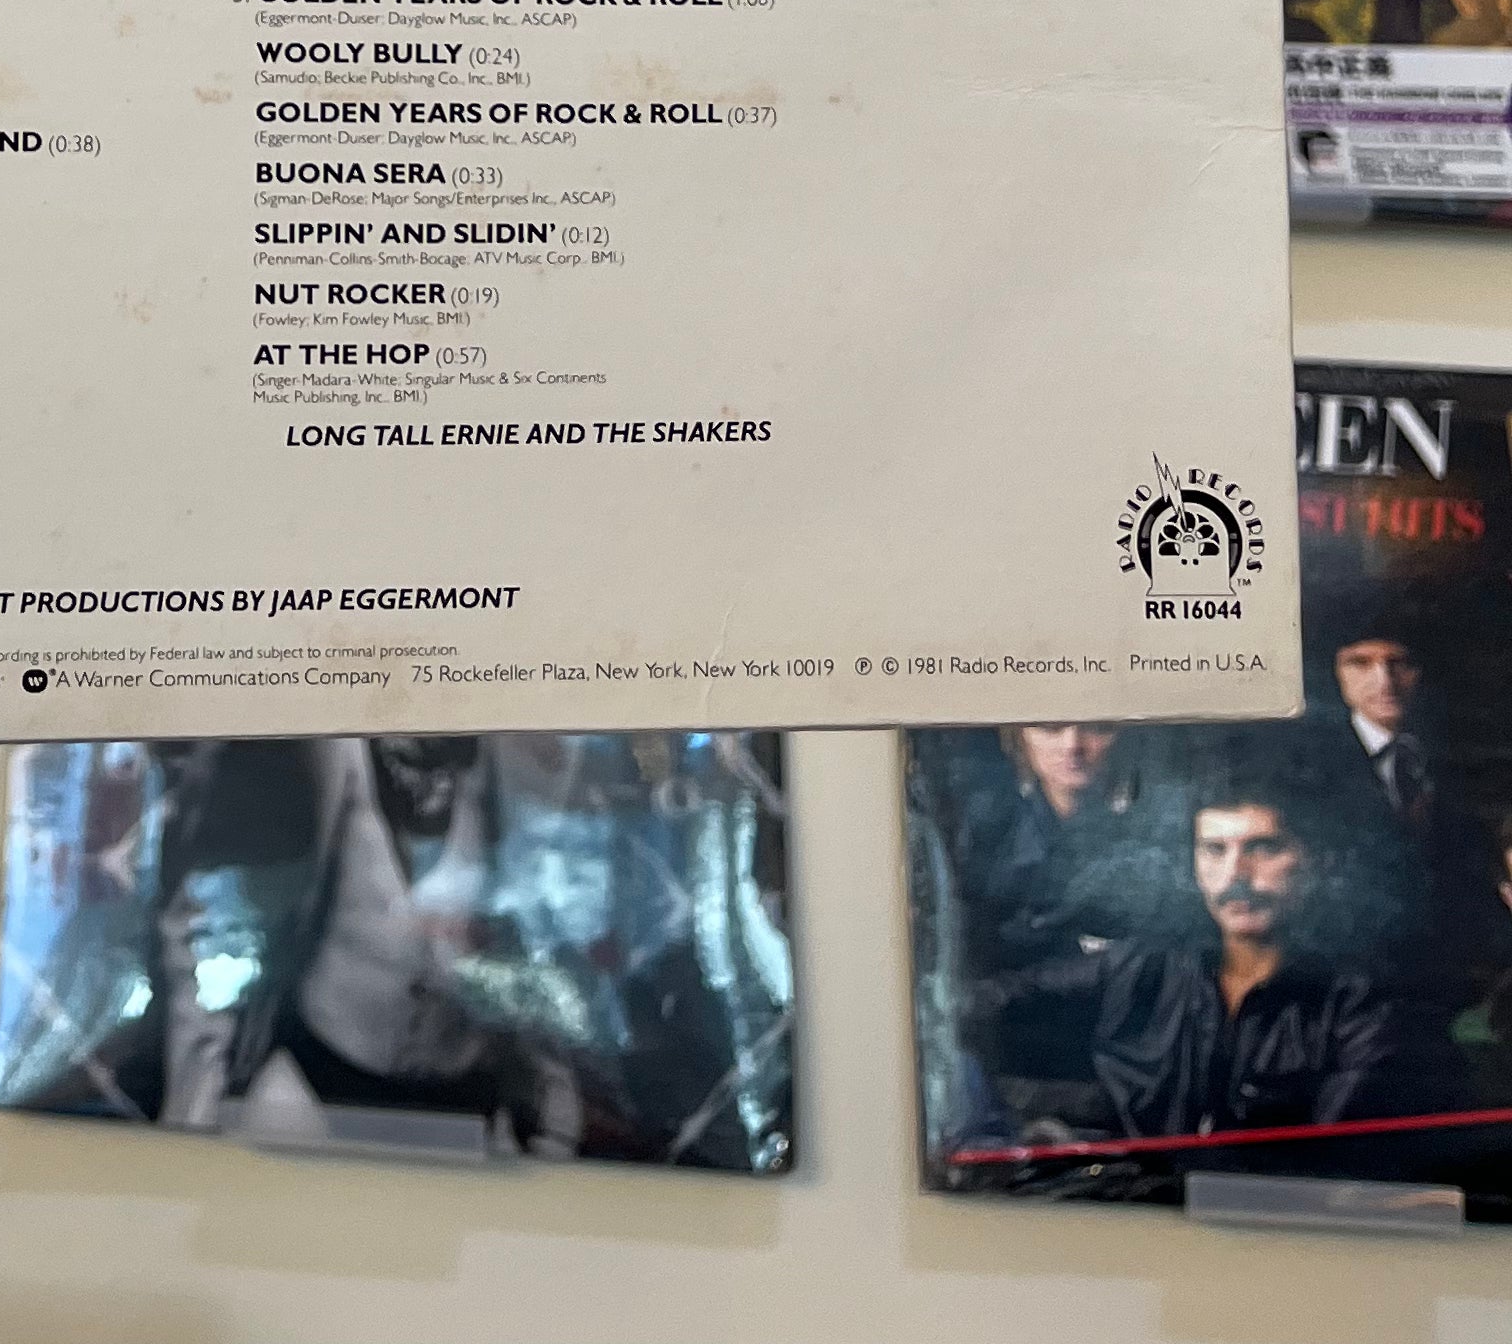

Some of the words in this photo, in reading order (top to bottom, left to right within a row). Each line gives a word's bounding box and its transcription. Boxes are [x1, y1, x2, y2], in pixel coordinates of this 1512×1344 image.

[254, 344, 291, 365] AT
[299, 343, 357, 366] THE
[367, 343, 430, 365] HOP
[436, 347, 486, 368] (0:57)
[1115, 483, 1153, 574] RADIO
[1188, 467, 1266, 574] RECORDS
[20, 590, 224, 614] PRODUCTIONS
[232, 589, 265, 612] BY
[268, 589, 332, 618] JAAP
[340, 587, 520, 610] EGGERMONT
[1145, 601, 1176, 619] RR
[1183, 600, 1241, 619] 16044
[42, 650, 52, 662] is
[55, 647, 126, 663] prohibited
[129, 647, 146, 663] by
[149, 646, 200, 661] Federal
[202, 646, 226, 660] law
[228, 646, 254, 660] and
[257, 645, 304, 662] subject
[307, 647, 322, 659] to
[325, 645, 376, 659] criminal
[908, 656, 942, 675] 1981
[951, 656, 998, 675] Radio
[1004, 655, 1078, 674] Records,
[1084, 656, 1111, 673] Inc.
[1130, 653, 1191, 672] Printed
[1197, 658, 1210, 672] in
